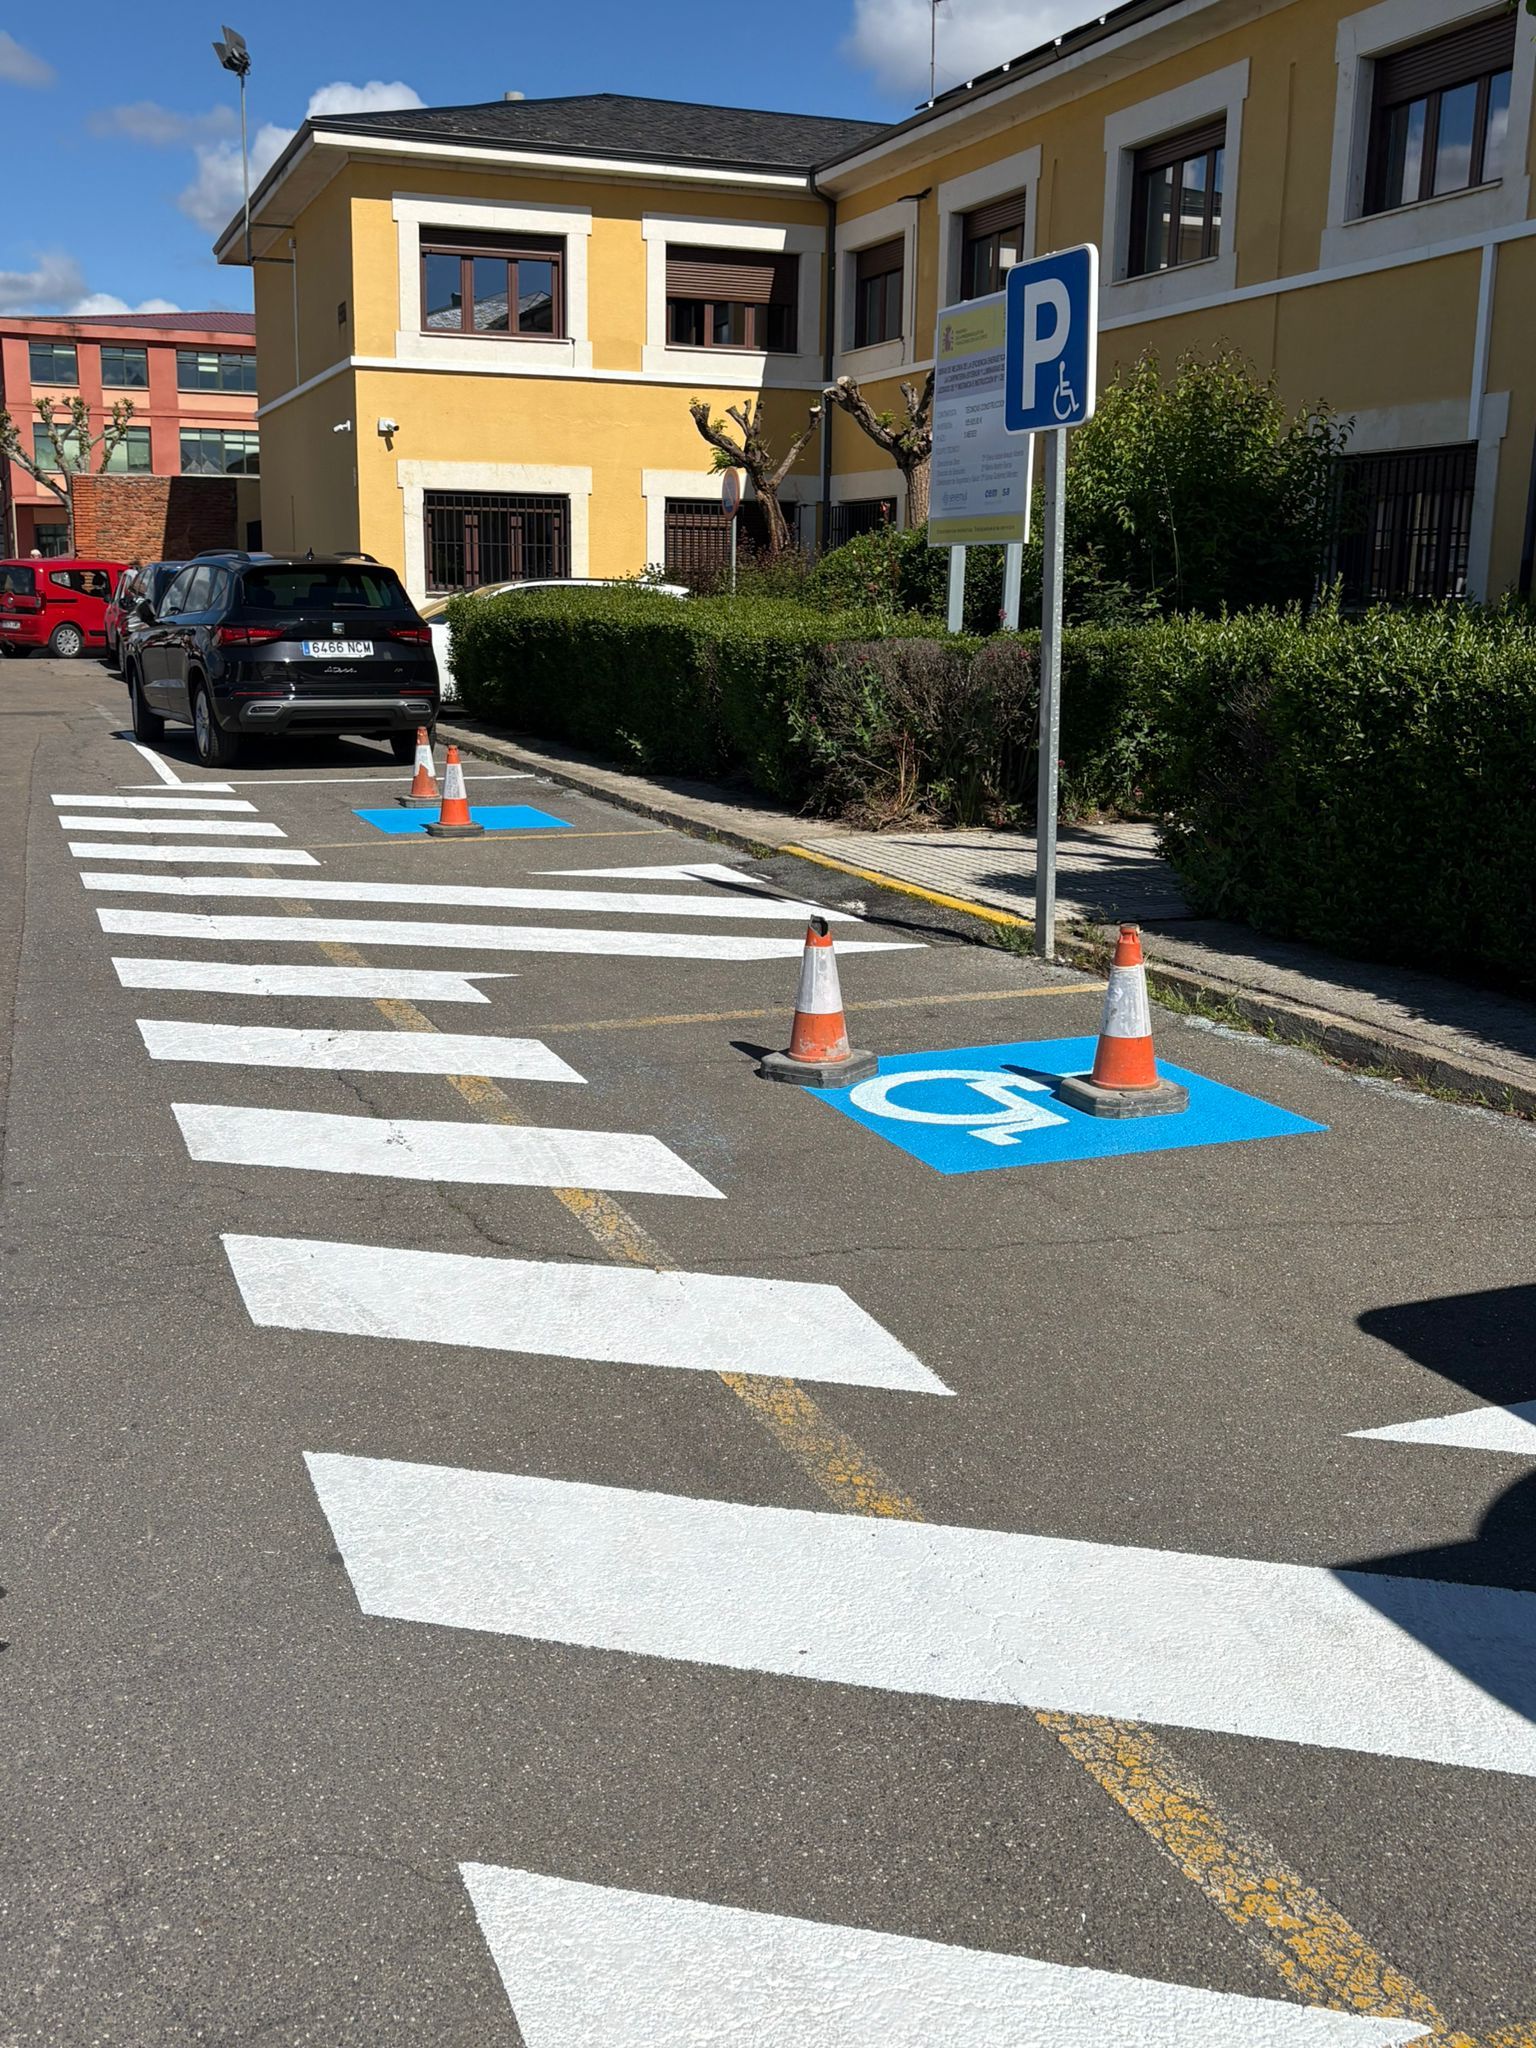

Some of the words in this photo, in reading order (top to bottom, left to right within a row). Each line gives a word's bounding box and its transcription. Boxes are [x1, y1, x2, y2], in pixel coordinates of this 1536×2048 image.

[1022, 278, 1071, 410] P
[313, 641, 344, 654] 6466
[347, 641, 372, 653] NCM
